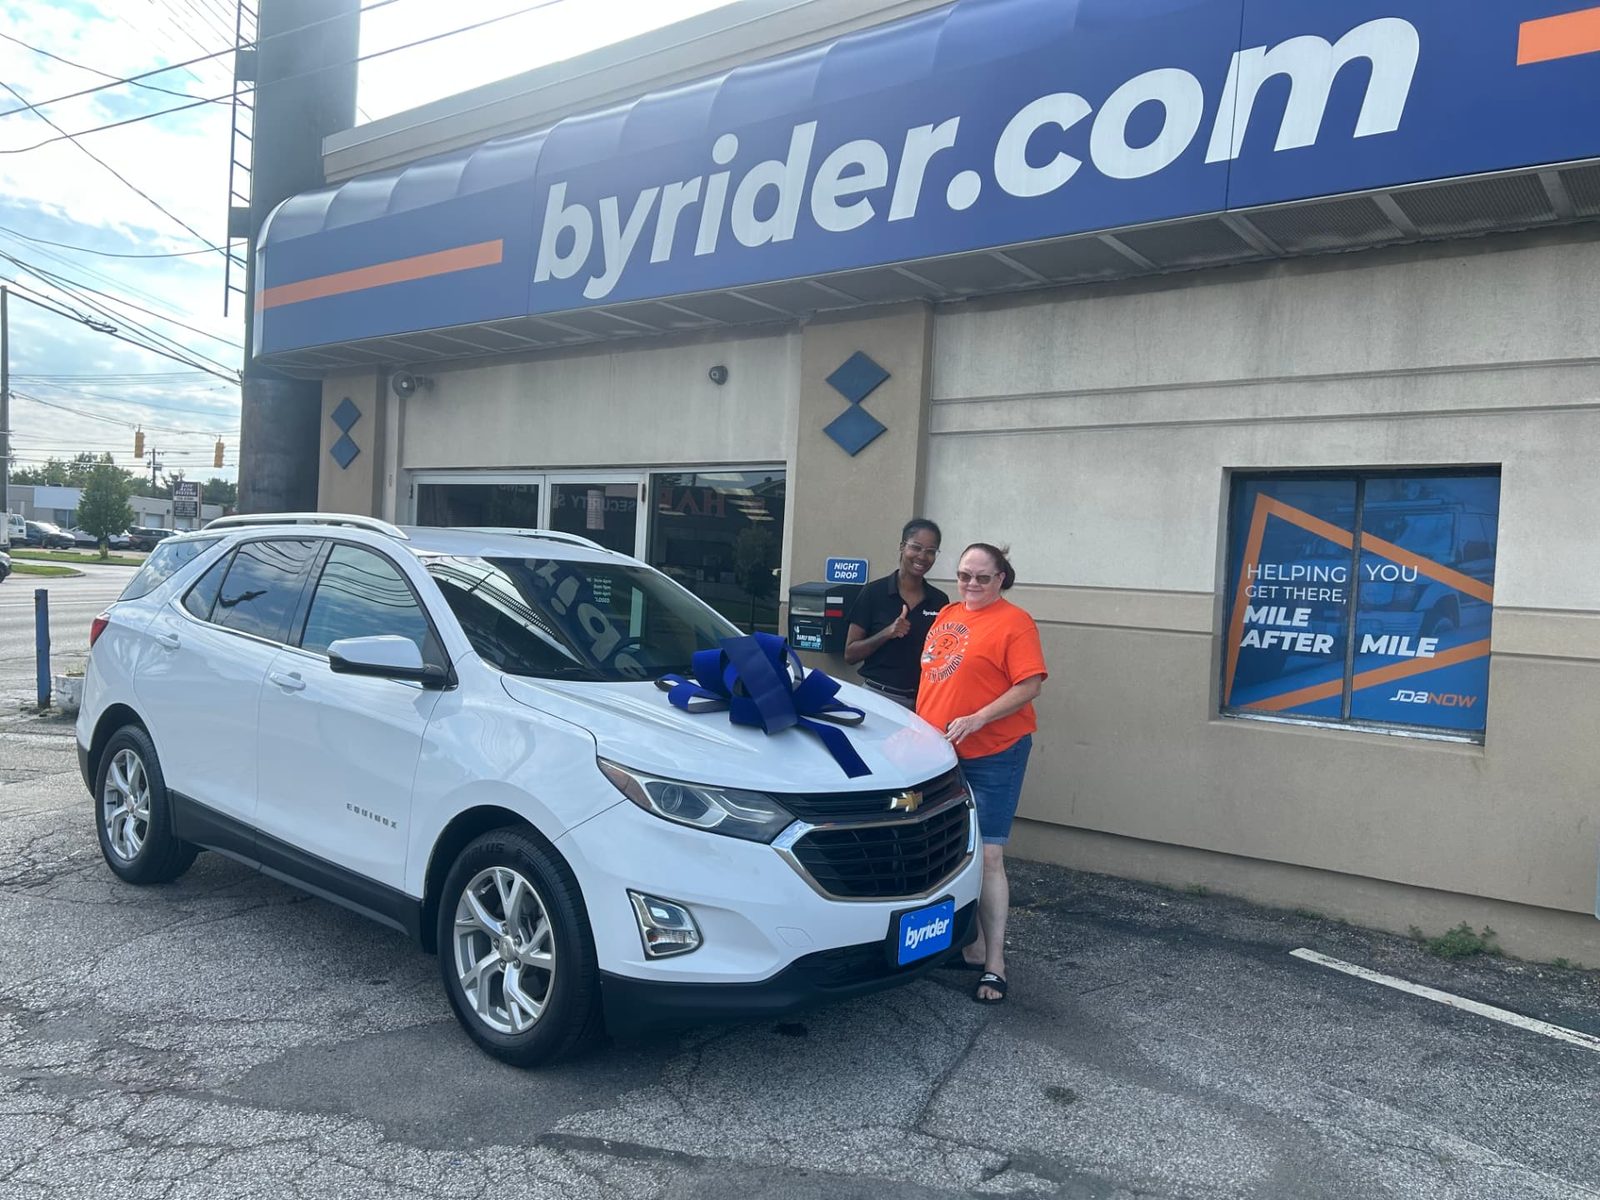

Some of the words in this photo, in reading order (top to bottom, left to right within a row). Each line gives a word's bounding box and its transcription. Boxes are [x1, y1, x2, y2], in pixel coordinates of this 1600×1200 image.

[533, 16, 1420, 300] byrider.com
[834, 563, 859, 571] NIGHT
[834, 571, 858, 579] DROP
[1247, 563, 1347, 583] HELPING
[1366, 563, 1419, 582] YOU
[1244, 585, 1279, 599] GET
[1283, 588, 1347, 604] THERE,
[1243, 605, 1312, 627] MILE
[1240, 629, 1334, 654] AFTER
[1359, 633, 1439, 658] MILE
[346, 802, 397, 829] EQUINOX
[905, 917, 950, 949] byrider
